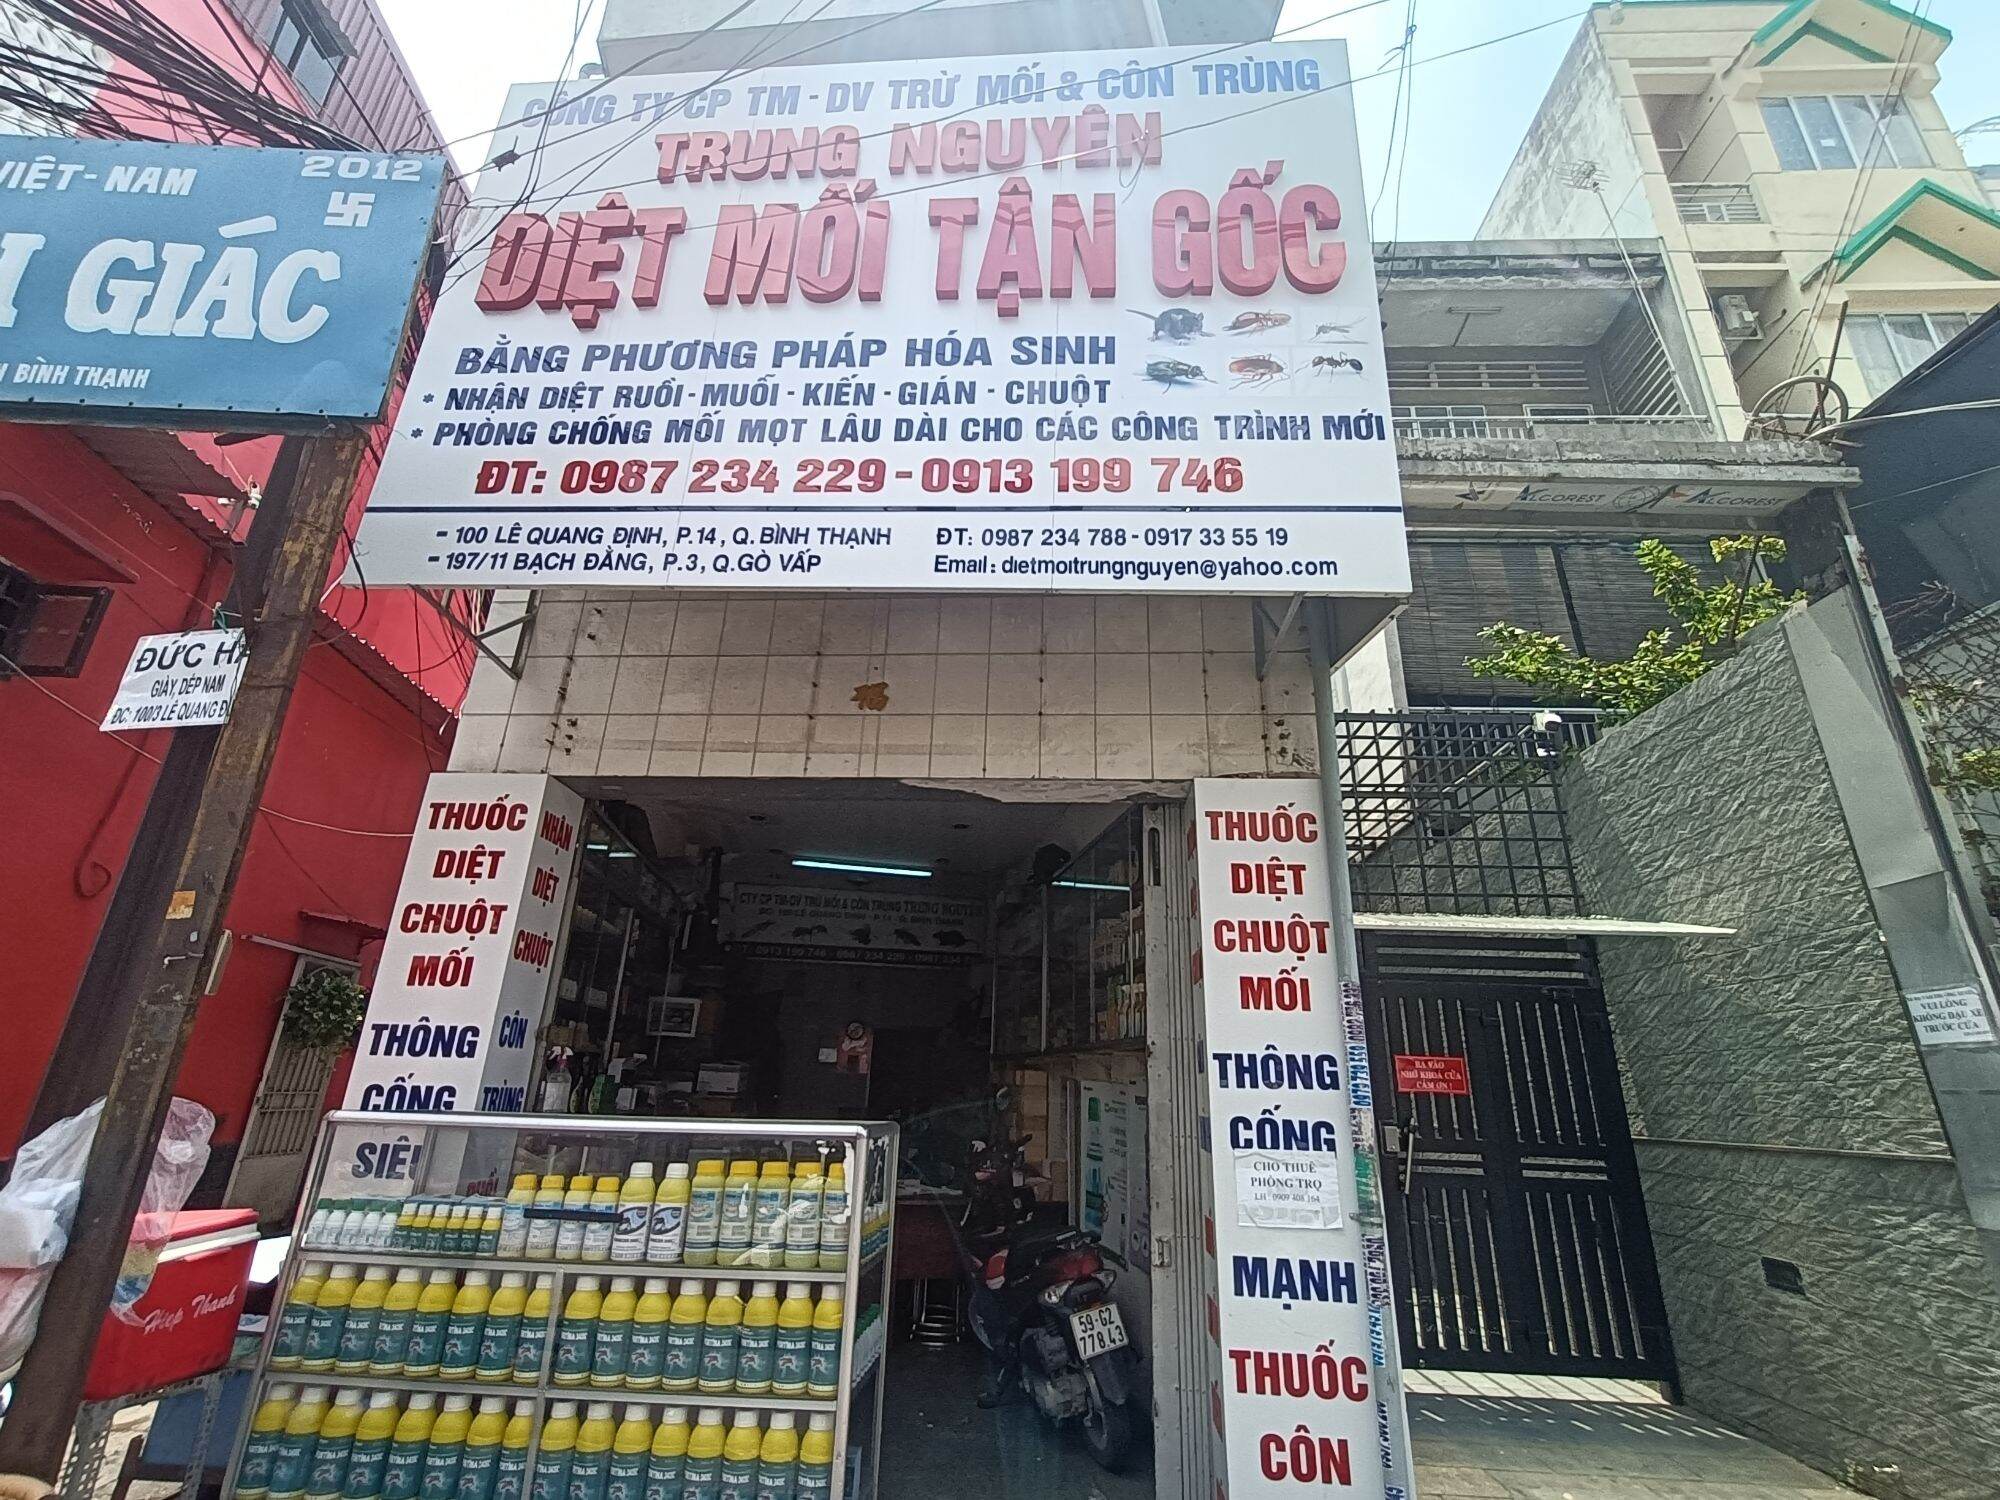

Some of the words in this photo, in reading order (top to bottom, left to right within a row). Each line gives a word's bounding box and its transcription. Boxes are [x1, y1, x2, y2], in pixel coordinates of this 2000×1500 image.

[522, 89, 617, 127] CÔNG
[631, 91, 675, 122] TY
[683, 88, 731, 118] CP
[747, 86, 801, 116] TM
[825, 81, 874, 113] DV
[887, 69, 960, 109] TRỪ
[976, 62, 1045, 106] MỐI
[1057, 71, 1088, 102] &
[1097, 60, 1174, 101] CÔN
[1192, 56, 1321, 96] TRÙNG
[655, 125, 860, 184] TRUNG
[889, 104, 1162, 175] NGUYÊN
[301, 155, 423, 182] 2012
[475, 190, 688, 331] DIỆT
[703, 178, 891, 307] MỐI
[928, 177, 1116, 317] TẬN
[1152, 160, 1347, 298] GỐC
[64, 215, 341, 343] GIÁC
[455, 334, 569, 375] BẰNG
[582, 340, 757, 371] PHƯƠNG
[771, 331, 887, 369] PHÁP
[904, 329, 992, 367] HÓA
[1011, 335, 1116, 365] SINH
[13, 356, 69, 385] BÌNH
[74, 365, 150, 389] THẠNH
[444, 381, 530, 414] NHẬN
[538, 381, 604, 413] DIỆT
[613, 377, 684, 409] RUỒI
[700, 374, 780, 408] MUỖI
[802, 374, 876, 407] KIẾN
[898, 375, 977, 406] GIÁN
[1005, 374, 1112, 409] CHUỘT
[432, 416, 538, 447] PHÒNG
[548, 413, 653, 446] CHỐNG
[664, 410, 726, 444] MỐI
[738, 418, 807, 447] MỌT
[821, 413, 882, 443] LÂU
[893, 412, 947, 443] DÀI
[961, 417, 1022, 443] CHO
[1036, 410, 1098, 442] CÁC
[1111, 411, 1198, 442] CÔNG
[1214, 409, 1310, 442] TRÌNH
[1322, 408, 1386, 441] MỚI
[474, 460, 547, 495] ĐT:
[559, 459, 679, 495] 0987
[687, 459, 780, 494] 234
[792, 458, 886, 494] 229
[920, 457, 1033, 494] 0913
[1050, 457, 1132, 494] 199
[1150, 456, 1246, 493] 746
[456, 527, 488, 544] 100
[495, 522, 522, 544] LÊ
[526, 527, 604, 545] QUANG
[612, 527, 668, 548] ĐỊNH,
[759, 523, 810, 545] BÌNH
[817, 527, 892, 549] THẠNH
[936, 527, 974, 547] ĐT:
[981, 527, 1032, 547] 0987
[1040, 527, 1080, 547] 234
[1087, 527, 1127, 546] 788
[1143, 527, 1193, 546] 0917
[1199, 527, 1225, 546] 33
[1231, 527, 1258, 546] 55
[1265, 527, 1288, 546] 19
[446, 552, 508, 570] 197/11
[513, 552, 576, 575] BẠCH
[779, 548, 822, 573] VẤP
[1001, 555, 1338, 582] dietmoitrungnguyen@yahoo.com
[135, 640, 206, 673] ĐỨC
[179, 673, 201, 695] DÉP
[203, 674, 226, 693] NAM
[178, 701, 217, 720] QUANG
[428, 793, 529, 832] THUỐC
[540, 810, 573, 855] NHẬN
[1204, 802, 1318, 843] THUỐC
[432, 844, 505, 885] DIỆT
[1230, 856, 1307, 902] DIỆT
[531, 867, 560, 907] DIỆT
[399, 898, 508, 941] CHUỘT
[1213, 913, 1330, 962] CHUỘT
[406, 946, 475, 987] MỐI
[513, 929, 554, 973] CHUỘT
[1239, 966, 1312, 1012] MỐI
[369, 1016, 481, 1058] THÔNG
[499, 1010, 528, 1049] CÔN
[1212, 1044, 1341, 1091] THÔNG
[360, 1072, 457, 1111] CỐNG
[482, 1079, 525, 1112] TRÙNG
[1229, 1104, 1337, 1152] CỐNG
[1250, 1175, 1293, 1189] PHÒNG
[1295, 1178, 1322, 1191] TRỌ
[1253, 1161, 1280, 1172] CHO
[1281, 1160, 1317, 1174] THUÊ
[1232, 1255, 1358, 1310] MẠNH
[1077, 1306, 1115, 1334] 59-G2
[1079, 1325, 1124, 1356] 778.43
[1228, 1339, 1369, 1402] THUỐC
[1260, 1424, 1352, 1486] CÔN
